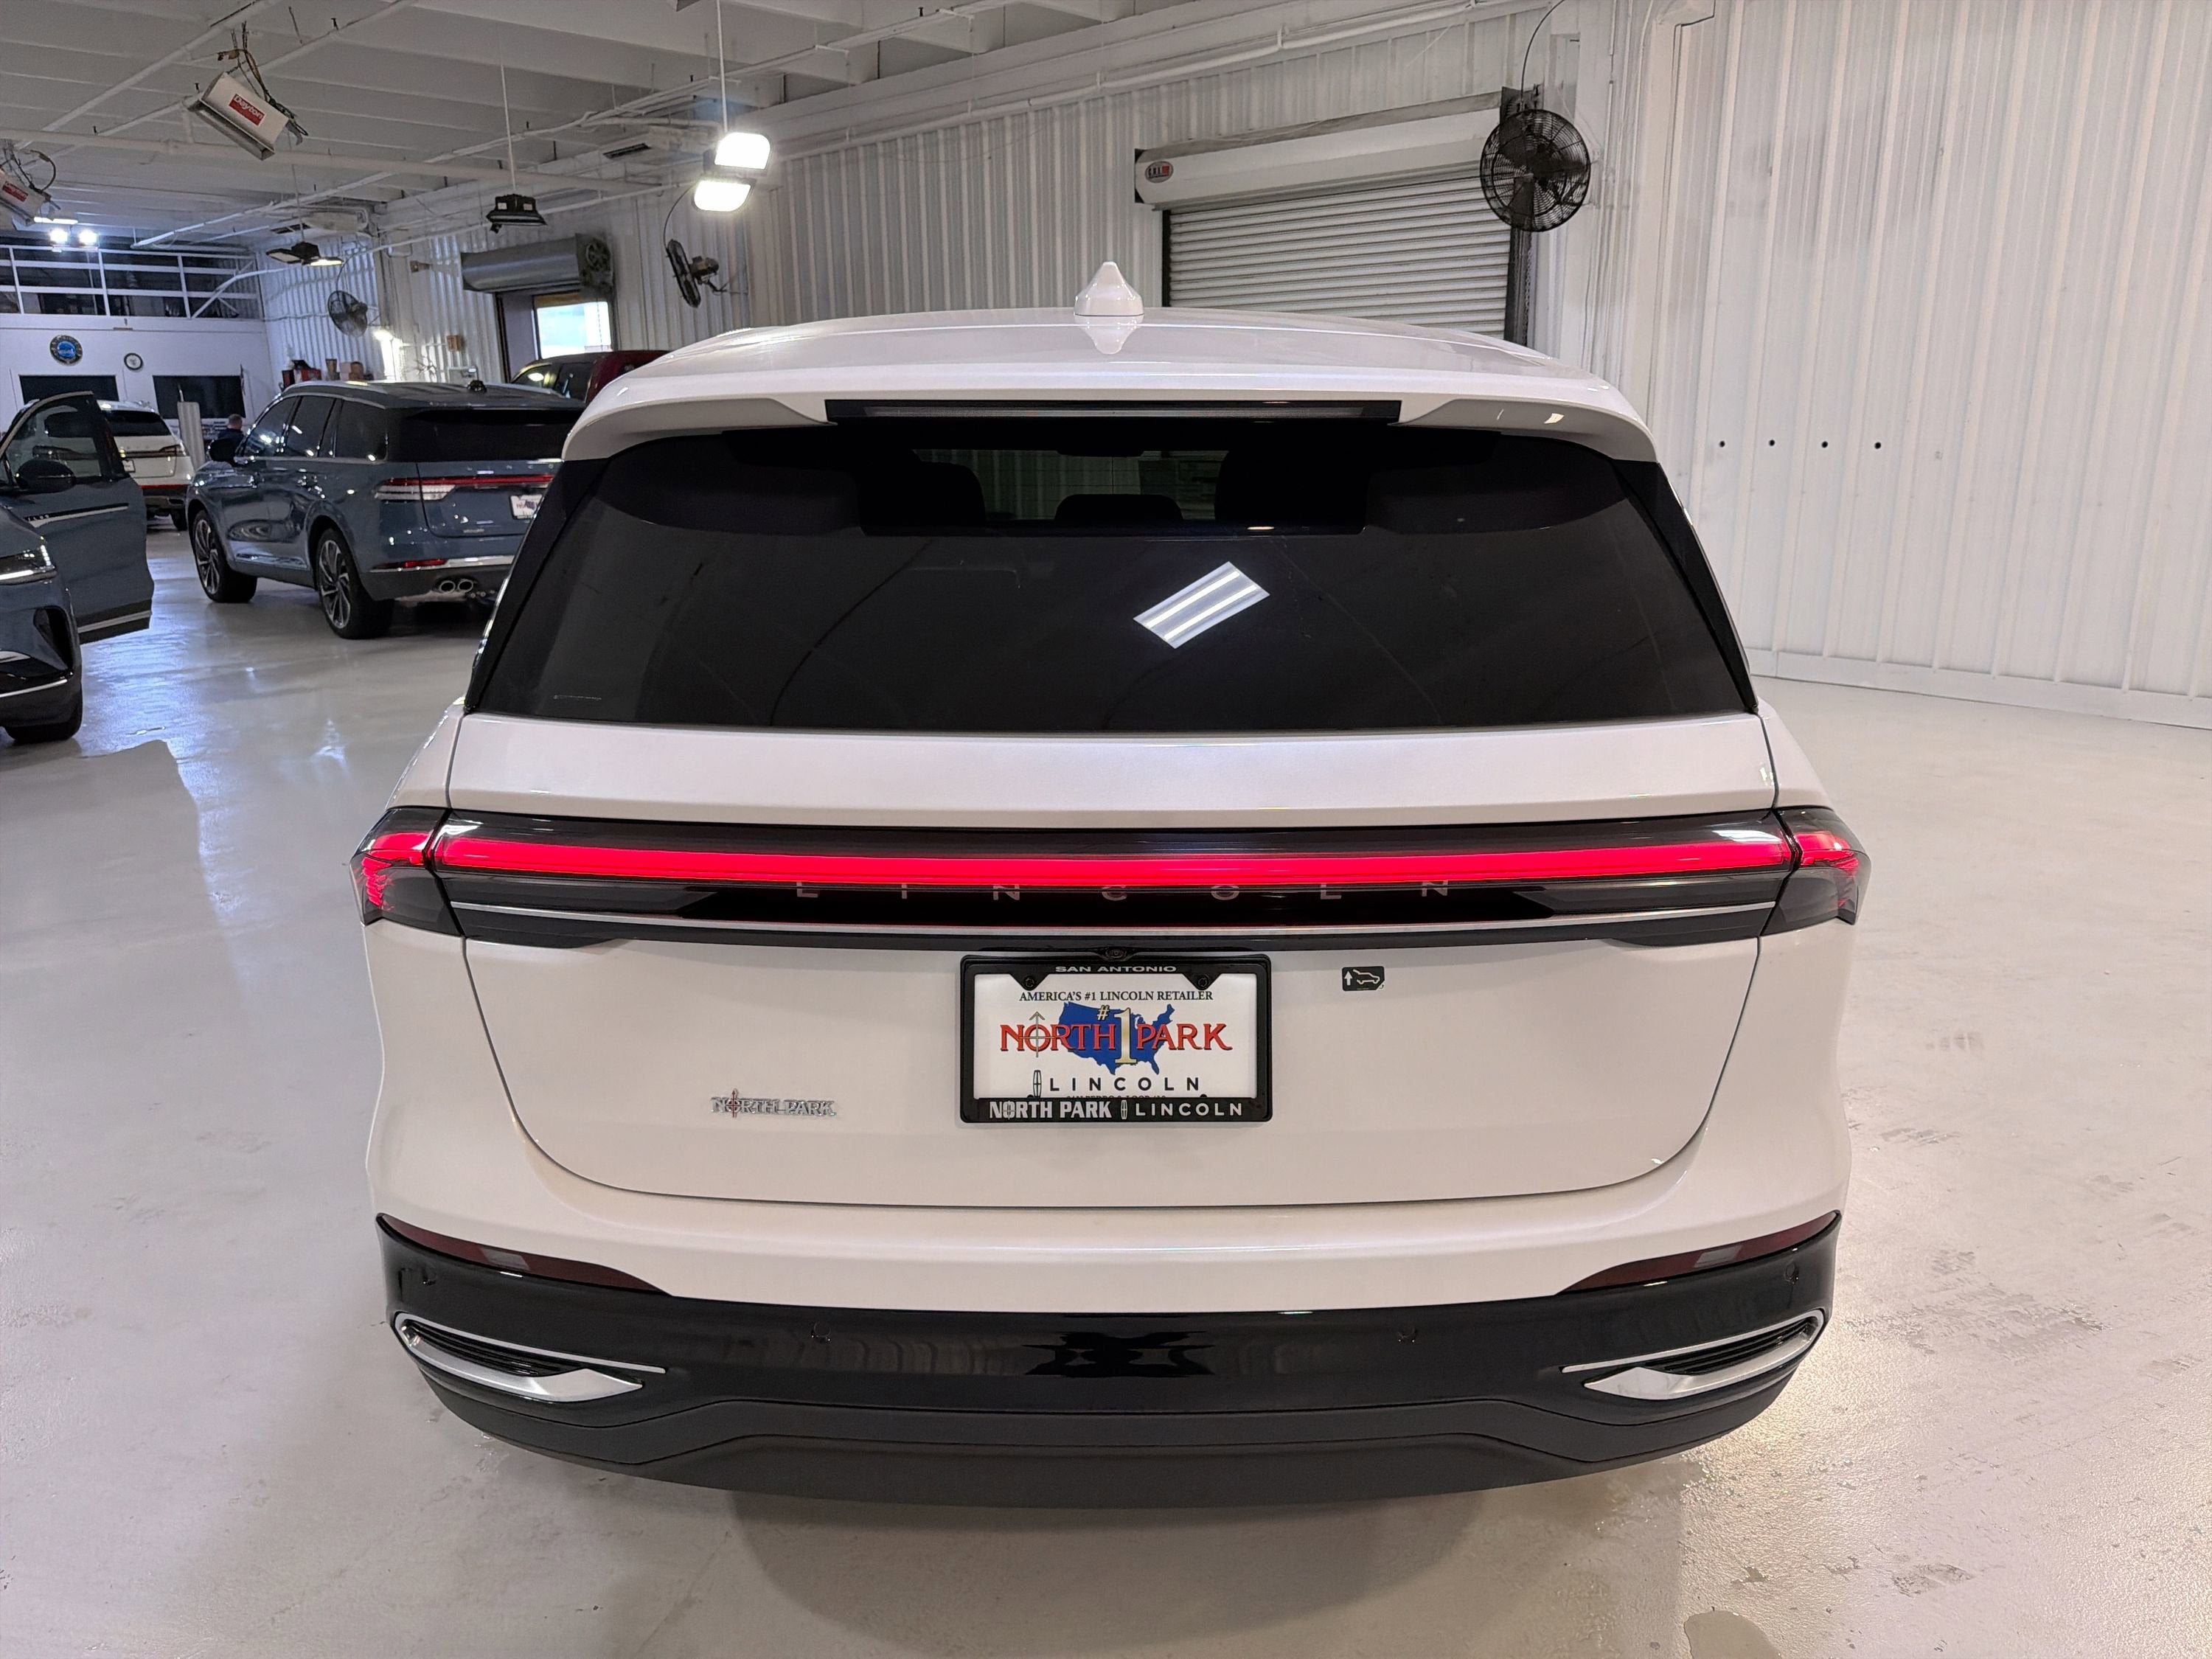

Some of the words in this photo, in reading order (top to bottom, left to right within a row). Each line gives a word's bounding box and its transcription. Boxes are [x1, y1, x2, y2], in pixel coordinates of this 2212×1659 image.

[796, 880, 1449, 900] LINCOLN
[1056, 965, 1091, 973] SAN
[1097, 965, 1177, 973] ANTONIO
[1019, 990, 1082, 1001] AMERICA'S
[1085, 990, 1096, 1001] #1
[1100, 991, 1155, 1001] LINCOLN
[1157, 990, 1214, 1001] RETAILER
[1000, 1023, 1116, 1051] NORTH
[1136, 1023, 1234, 1051] PARK
[1049, 1077, 1200, 1092] LINCOLN
[711, 1097, 780, 1113] NORTH
[784, 1099, 837, 1116] PARK
[990, 1101, 1053, 1119] NORTH
[1060, 1101, 1113, 1119] PARK
[1135, 1102, 1243, 1116] LINCOLN
